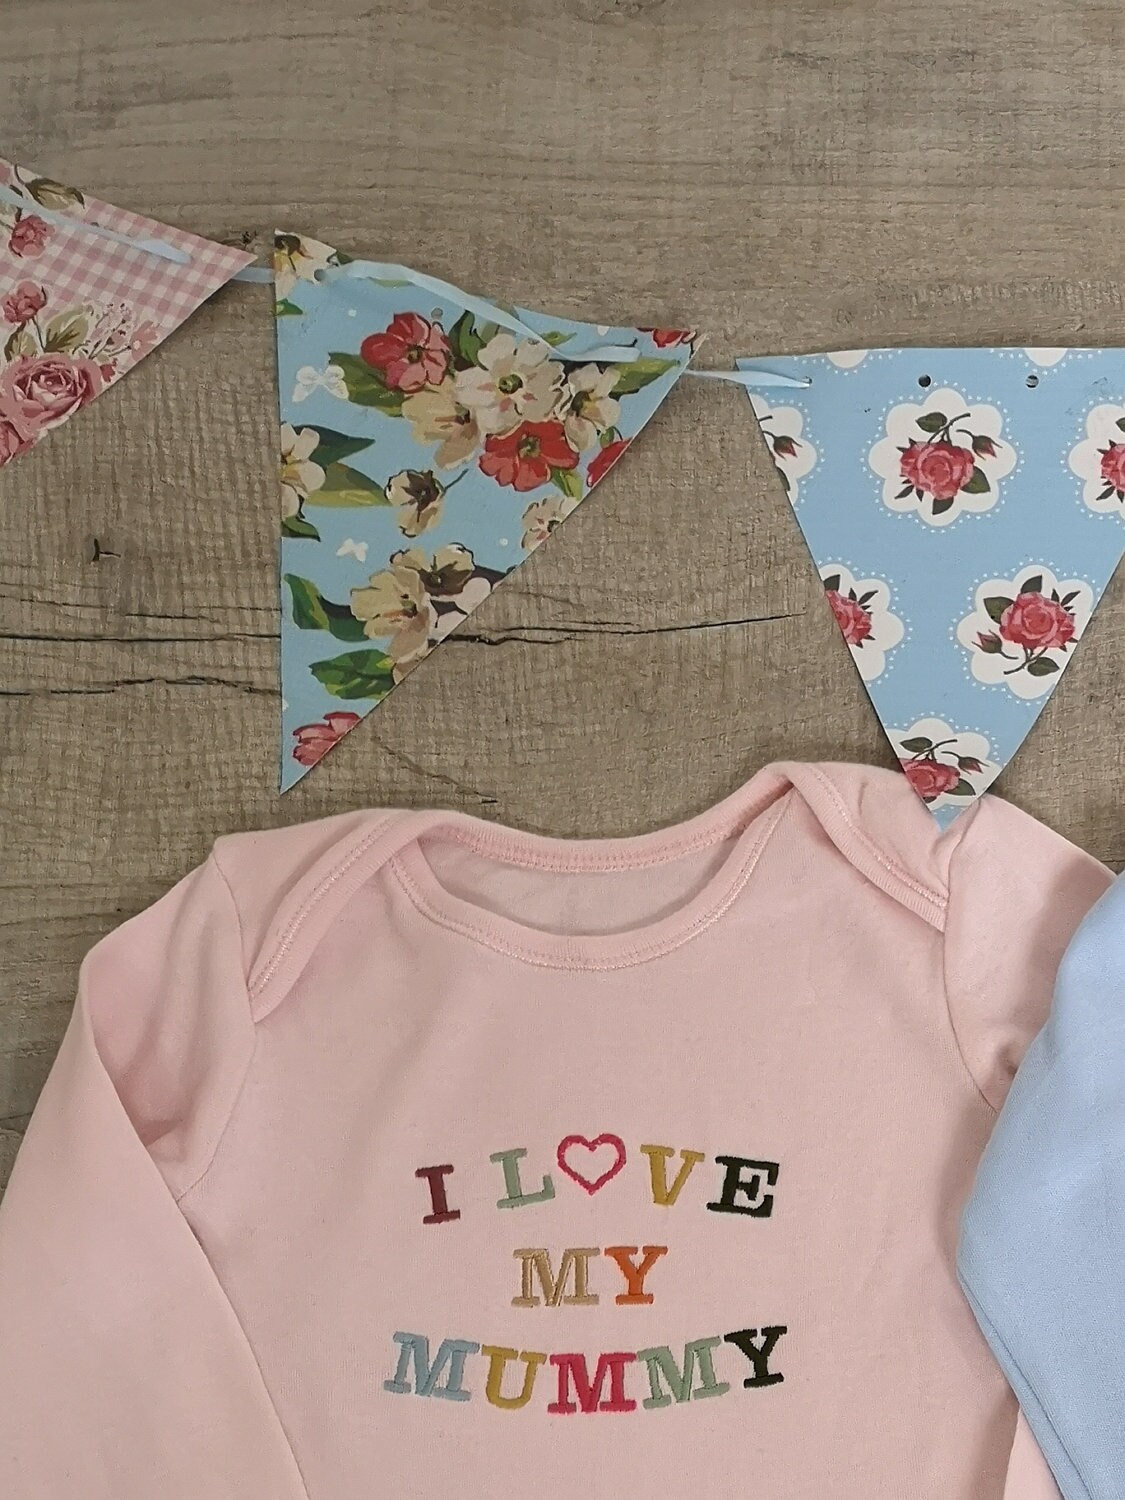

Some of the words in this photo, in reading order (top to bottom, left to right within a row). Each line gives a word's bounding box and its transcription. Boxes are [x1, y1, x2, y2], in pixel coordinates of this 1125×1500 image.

[415, 1163, 461, 1225] I
[511, 1246, 669, 1307] MY
[383, 1325, 788, 1415] MUMMY
